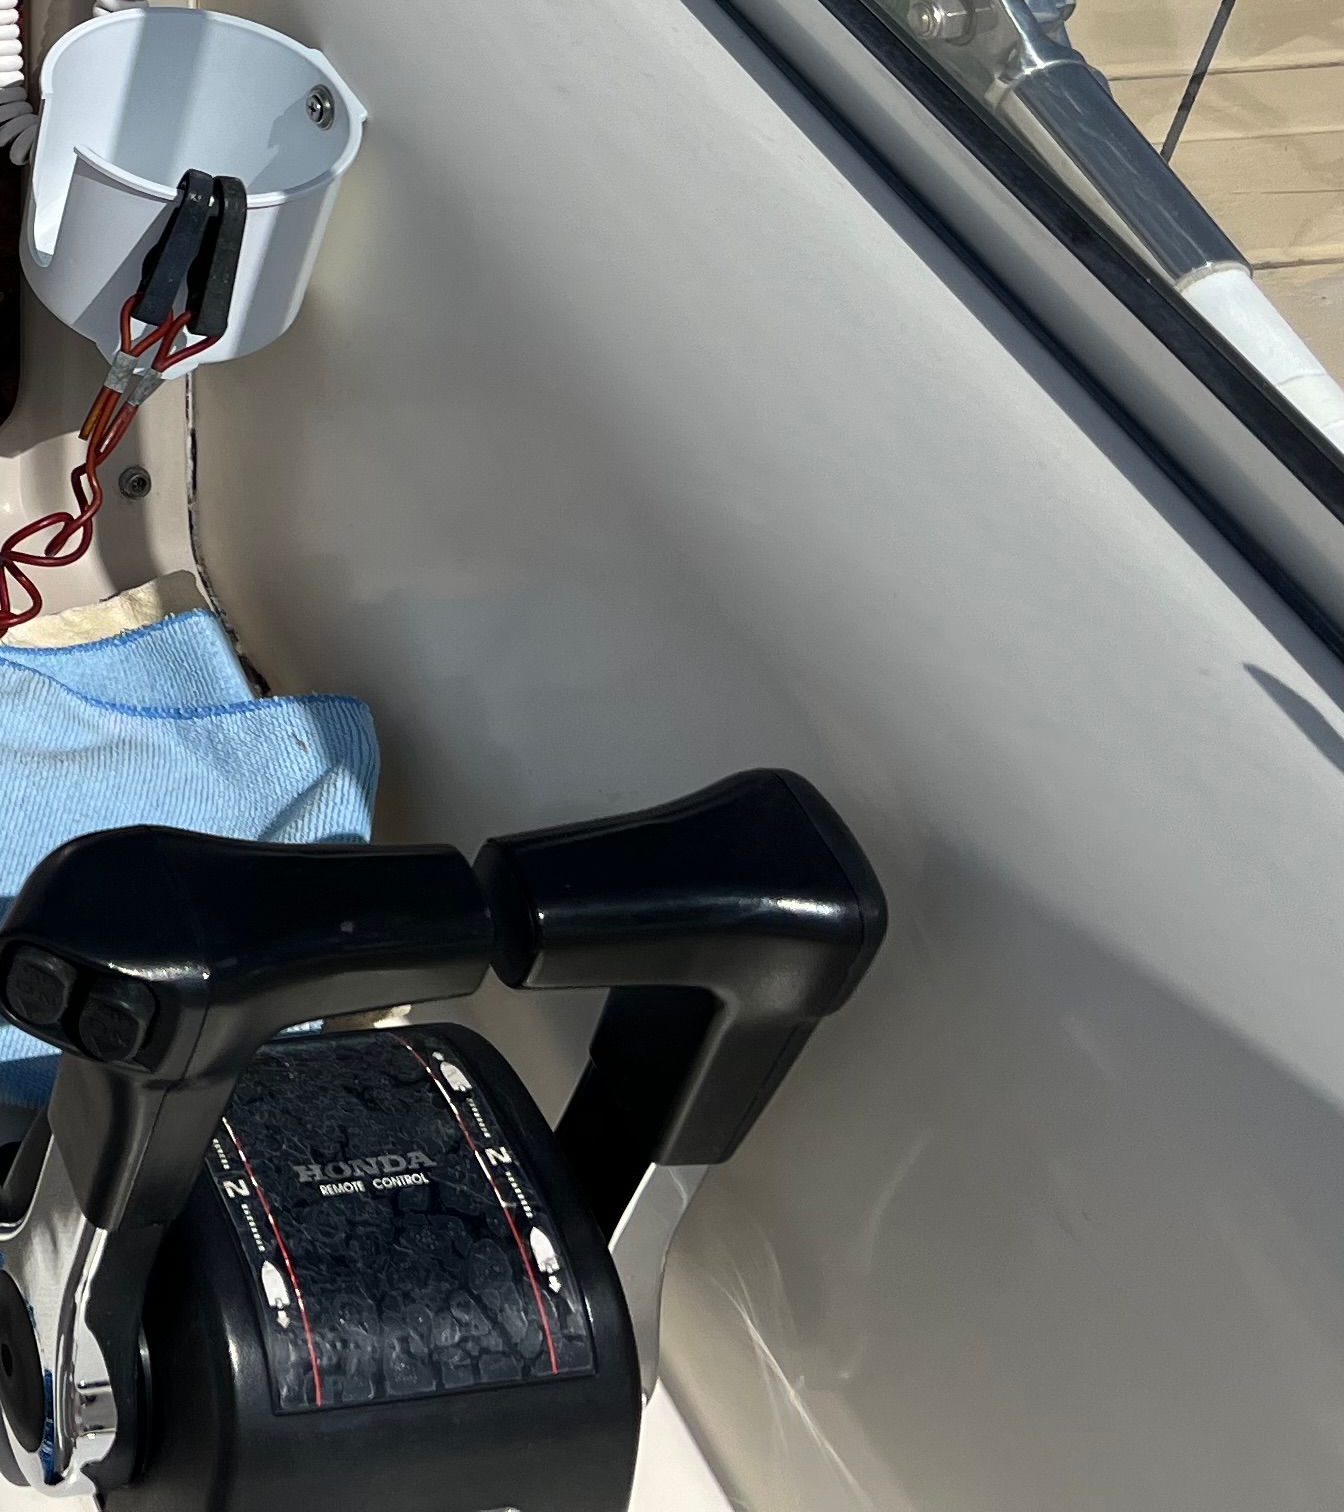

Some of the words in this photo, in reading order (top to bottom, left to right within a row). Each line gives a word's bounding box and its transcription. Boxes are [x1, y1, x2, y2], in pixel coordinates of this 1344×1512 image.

[293, 1150, 436, 1183] HONDA
[485, 1146, 512, 1166] N
[223, 1175, 251, 1199] N
[319, 1178, 367, 1197] REMOTE
[371, 1172, 430, 1191] CONTROL
